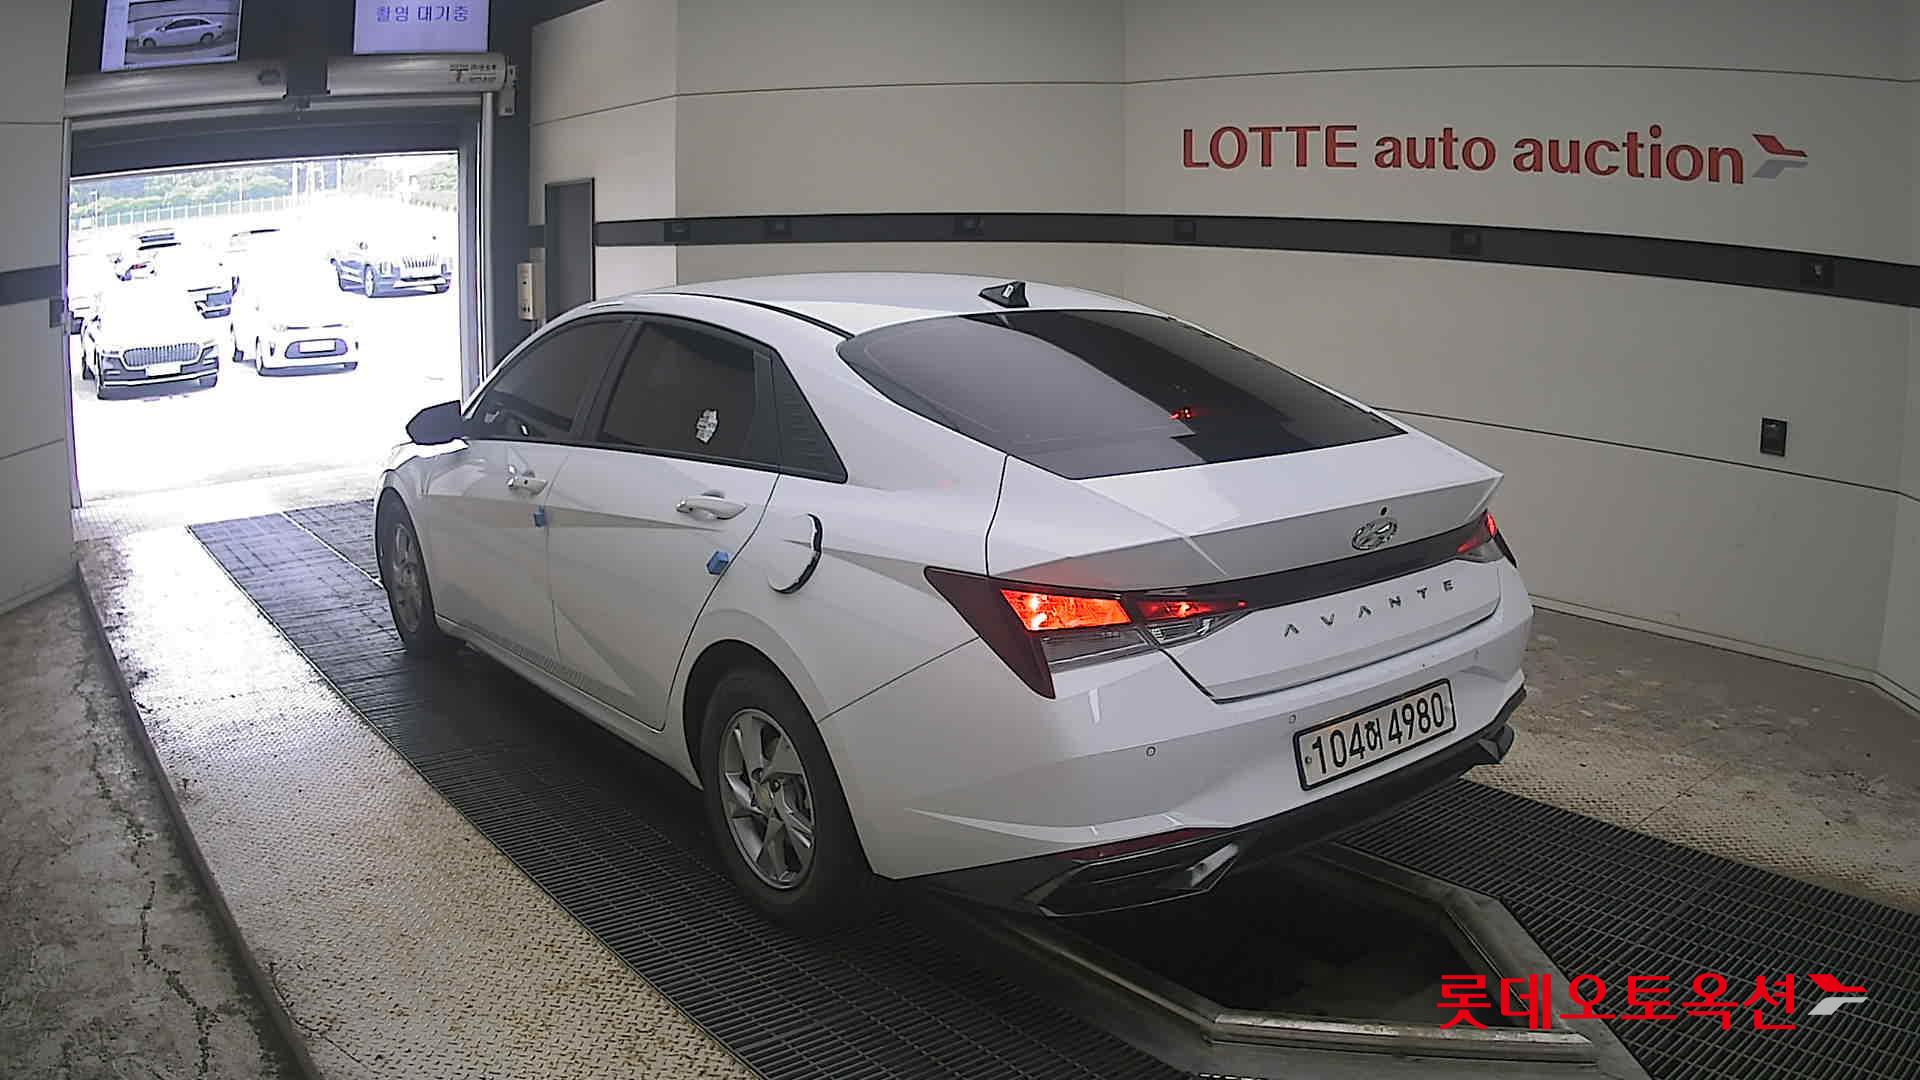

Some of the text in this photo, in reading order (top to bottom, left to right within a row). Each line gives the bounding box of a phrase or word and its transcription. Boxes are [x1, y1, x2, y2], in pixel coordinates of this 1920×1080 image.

[1183, 124, 1744, 184] LOTTE auto auction
[1283, 579, 1454, 637] AVANTE
[1388, 692, 1445, 744] 4980
